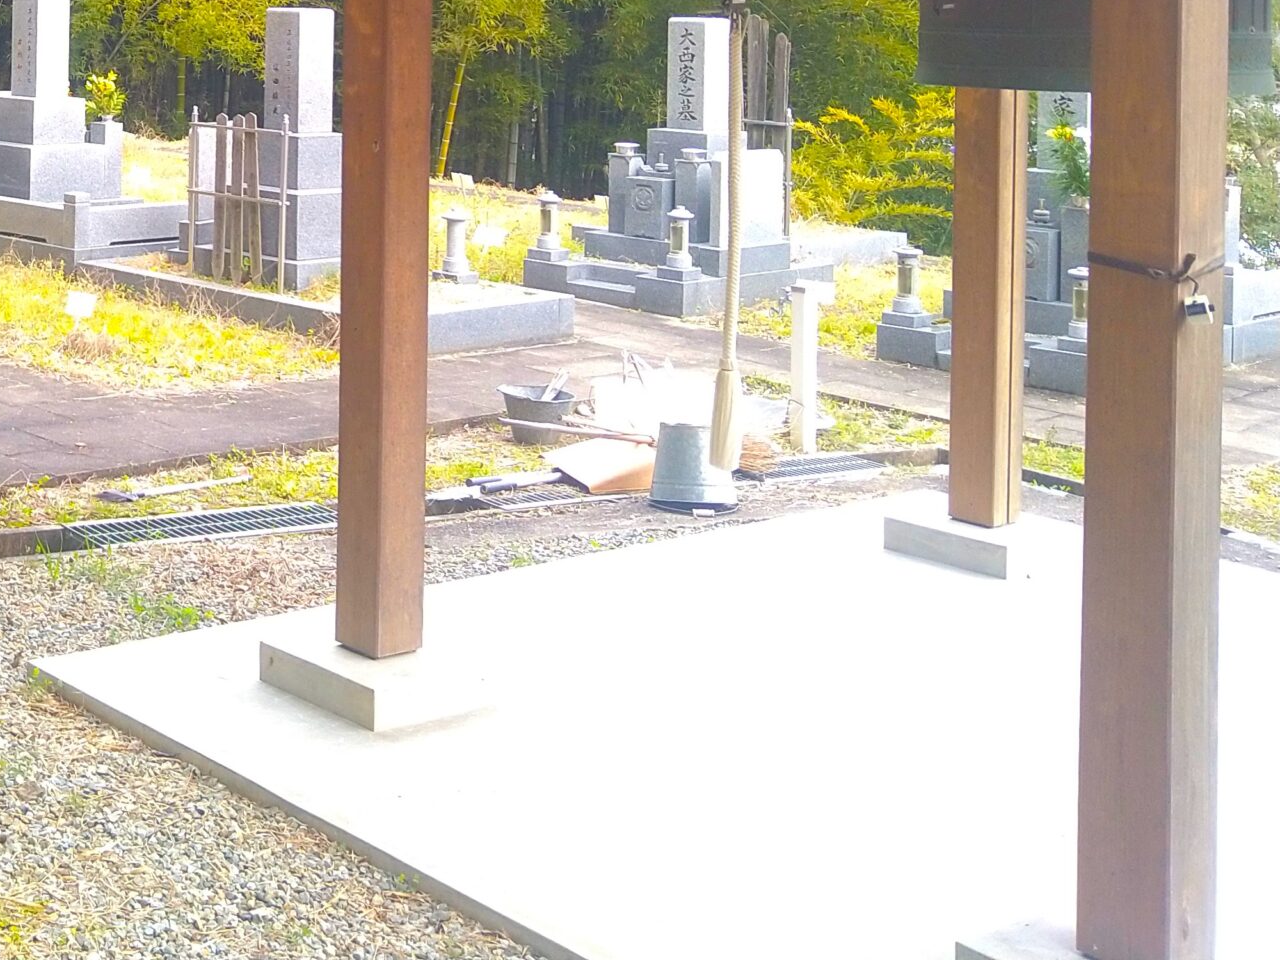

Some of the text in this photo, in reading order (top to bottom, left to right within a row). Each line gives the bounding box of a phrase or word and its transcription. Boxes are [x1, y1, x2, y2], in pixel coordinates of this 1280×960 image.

[676, 27, 698, 121] 大西家之墓
